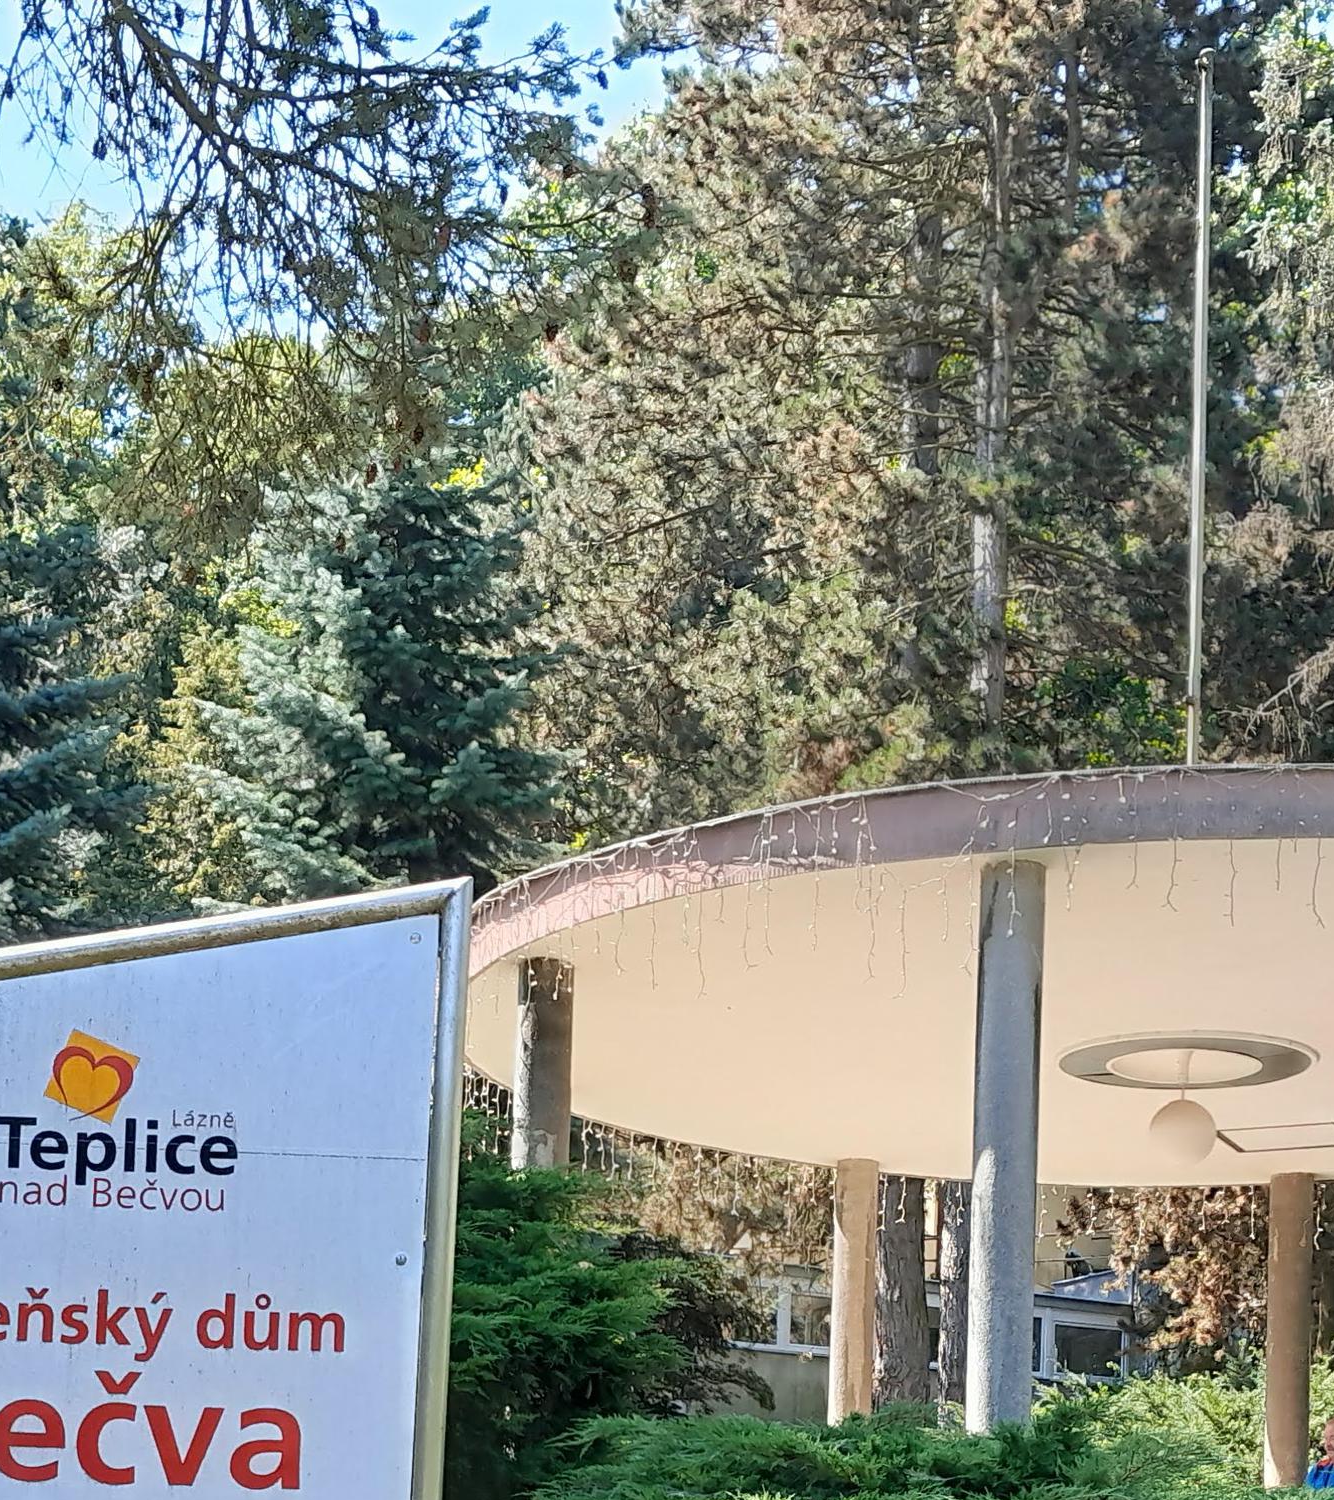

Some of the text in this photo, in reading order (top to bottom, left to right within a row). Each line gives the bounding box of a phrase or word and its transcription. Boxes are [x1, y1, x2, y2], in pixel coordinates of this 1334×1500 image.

[171, 1108, 235, 1129] Lázně
[92, 1176, 225, 1212] Bečvou
[196, 1292, 346, 1353] dům
